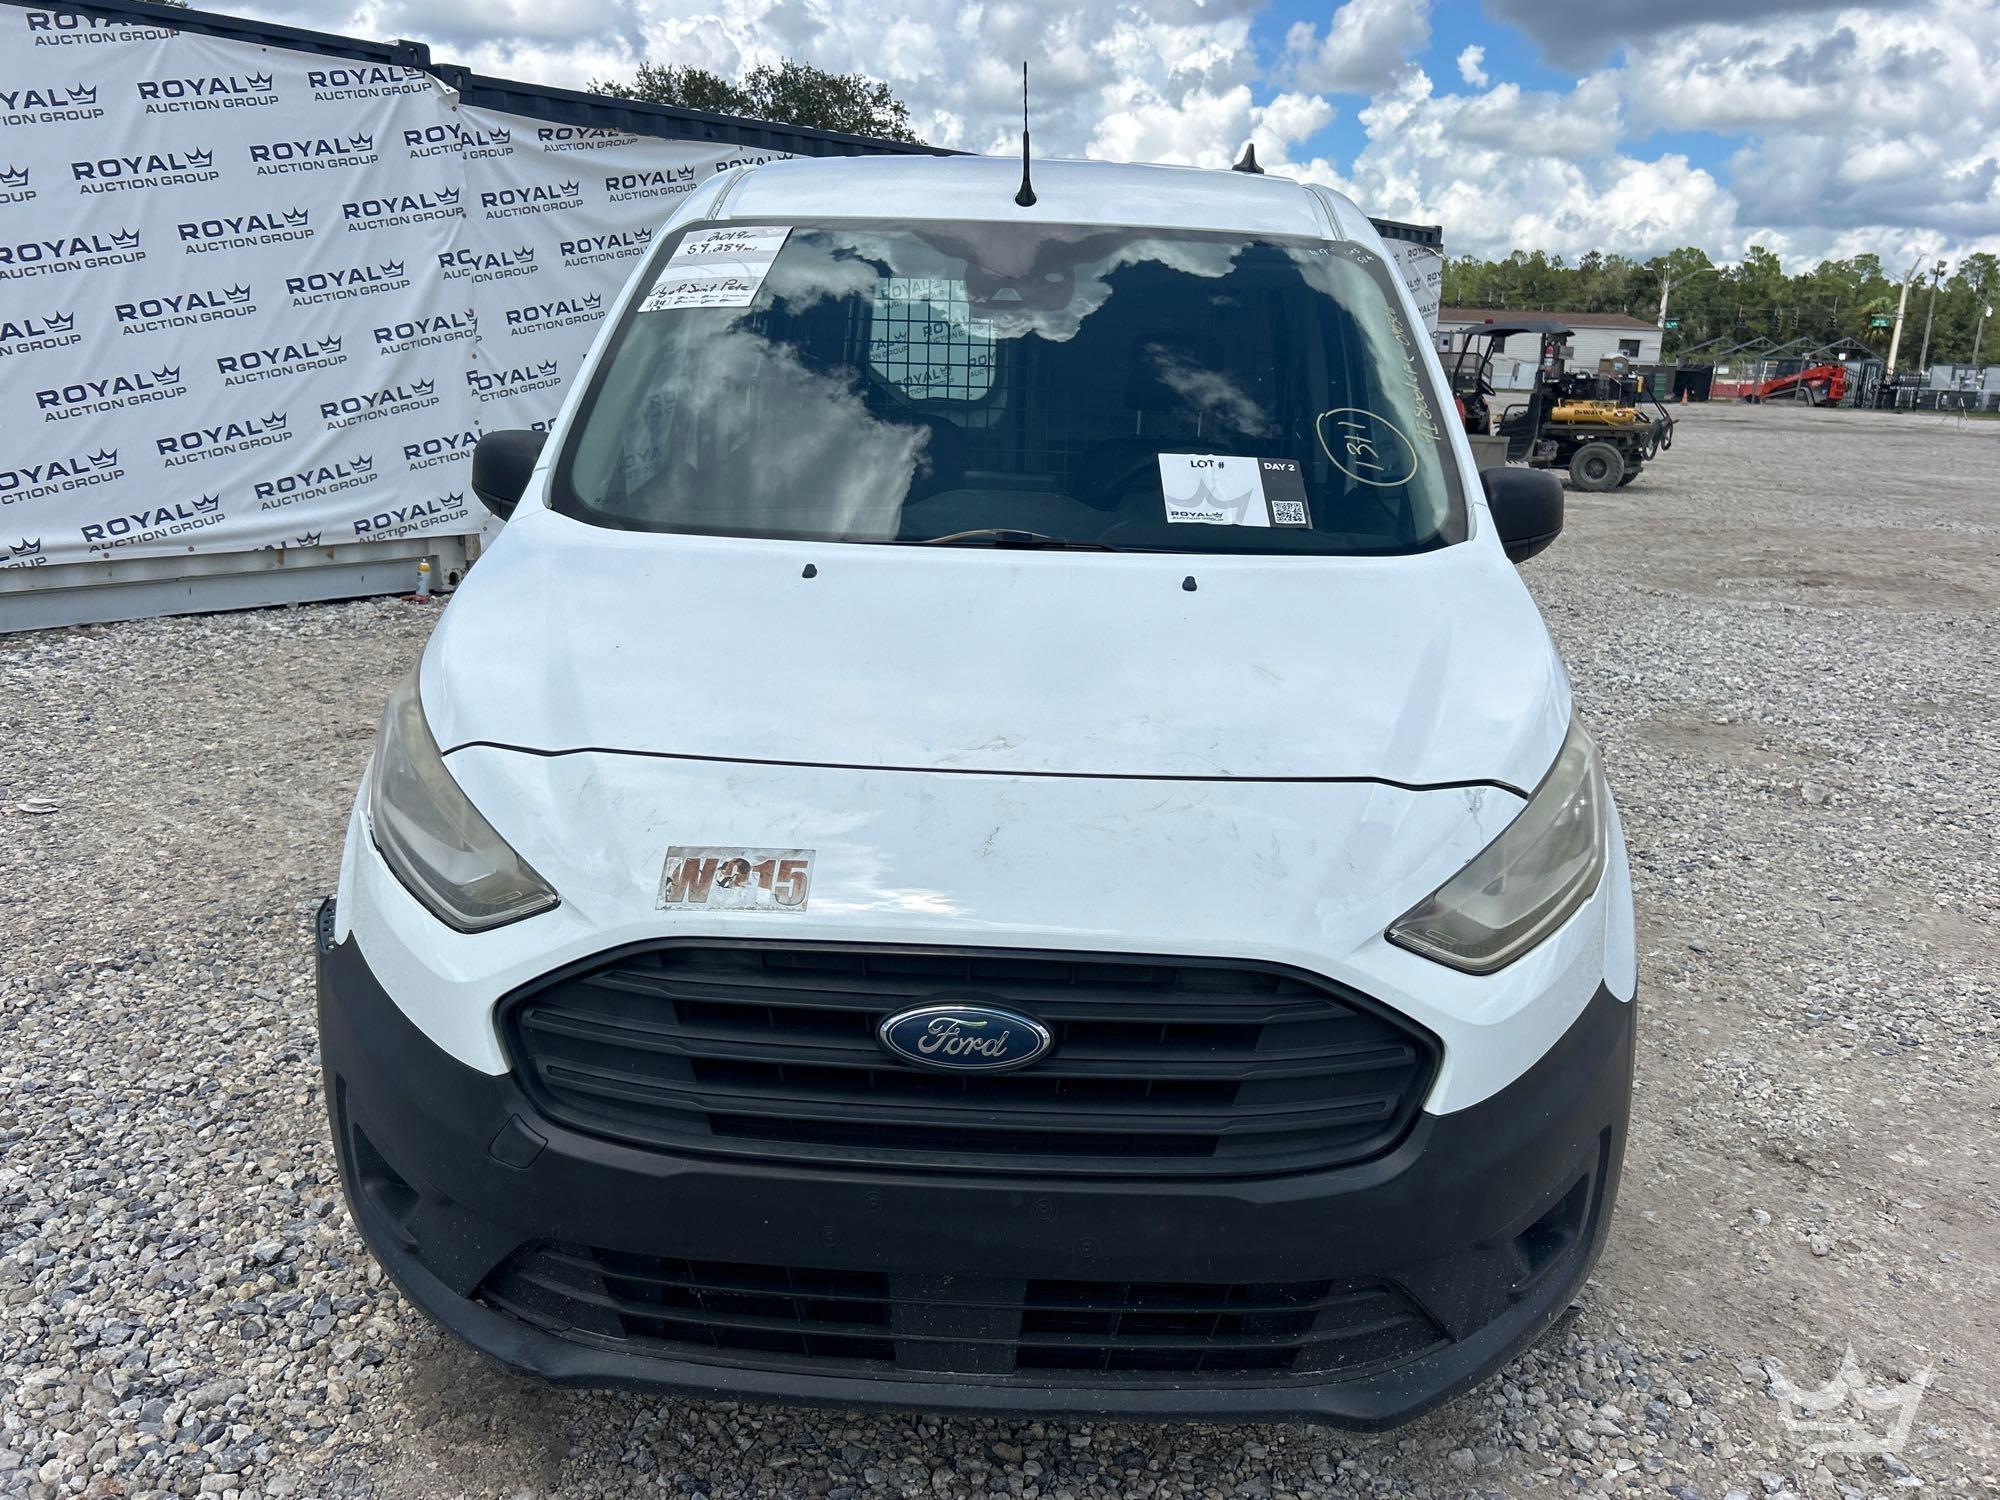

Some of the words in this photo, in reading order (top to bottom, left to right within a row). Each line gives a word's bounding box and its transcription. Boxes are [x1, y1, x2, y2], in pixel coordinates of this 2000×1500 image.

[35, 32, 116, 46] AUCTION
[120, 29, 181, 42] GROUP
[137, 76, 247, 100] ROYAL
[307, 67, 403, 88] ROYAL
[314, 88, 378, 101] AUCTION
[381, 82, 432, 96] GROUP
[40, 109, 104, 123] GROUP
[145, 100, 220, 114] AUCTION
[223, 95, 279, 108] GROUP
[404, 123, 489, 147] ROYAL
[544, 142, 594, 153] AUCTION
[597, 138, 638, 149] GROUP
[250, 137, 350, 163] ROYAL
[470, 148, 513, 160] GROUP
[71, 153, 187, 181] ROYAL
[257, 161, 325, 176] AUCTION
[328, 154, 379, 168] GROUP
[80, 178, 158, 194] AUCTION
[161, 171, 219, 186] GROUP
[605, 170, 677, 191] ROYAL
[609, 188, 658, 203] AUCTION
[660, 183, 697, 195] GROUP
[343, 193, 437, 220] ROYAL
[481, 185, 561, 208] ROYAL
[348, 218, 412, 232] AUCTION
[413, 207, 464, 224] GROUP
[485, 205, 541, 220] AUCTION
[543, 200, 584, 212] GROUP
[177, 214, 284, 241] ROYAL
[0, 235, 112, 264] ROYAL
[185, 239, 257, 254] AUCTION
[261, 229, 314, 243] GROUP
[560, 233, 634, 256] ROYAL
[0, 260, 81, 280] AUCTION
[84, 252, 146, 268] GROUP
[495, 265, 538, 279] GROUP
[564, 254, 614, 268] AUCTION
[286, 266, 382, 294] ROYAL
[115, 290, 226, 322] ROYAL
[292, 290, 359, 307] AUCTION
[361, 280, 410, 295] GROUP
[122, 314, 199, 335] AUCTION
[200, 305, 257, 323] GROUP
[506, 298, 584, 325] ROYAL
[511, 320, 563, 336] AUCTION
[565, 310, 605, 325] GROUP
[374, 313, 466, 343] ROYAL
[17, 334, 81, 353] GROUP
[380, 335, 442, 355] AUCTION
[217, 342, 319, 374] ROYAL
[224, 364, 293, 387] AUCTION
[296, 355, 347, 373] GROUP
[36, 374, 154, 409] ROYAL
[520, 377, 561, 393] GROUP
[44, 399, 124, 422] AUCTION
[127, 386, 187, 406] GROUP
[320, 386, 412, 419] ROYAL
[327, 409, 388, 430] AUCTION
[390, 397, 439, 414] GROUP
[157, 420, 263, 455] ROYAL
[164, 444, 237, 468] AUCTION
[239, 431, 293, 452] GROUP
[409, 450, 470, 471] AUCTION
[1190, 459, 1214, 468] LOT
[1218, 461, 1225, 470] #
[1264, 462, 1286, 471] DAY
[1288, 463, 1296, 472] 2
[62, 469, 124, 491] GROUP
[254, 463, 351, 499] ROYAL
[261, 488, 327, 511] AUCTION
[329, 473, 378, 492] GROUP
[81, 504, 194, 543] ROYAL
[354, 500, 441, 535] ROYAL
[421, 509, 468, 529] GROUP
[89, 529, 167, 553] AUCTION
[170, 513, 225, 535] GROUP
[918, 1017, 1010, 1057] Ford
